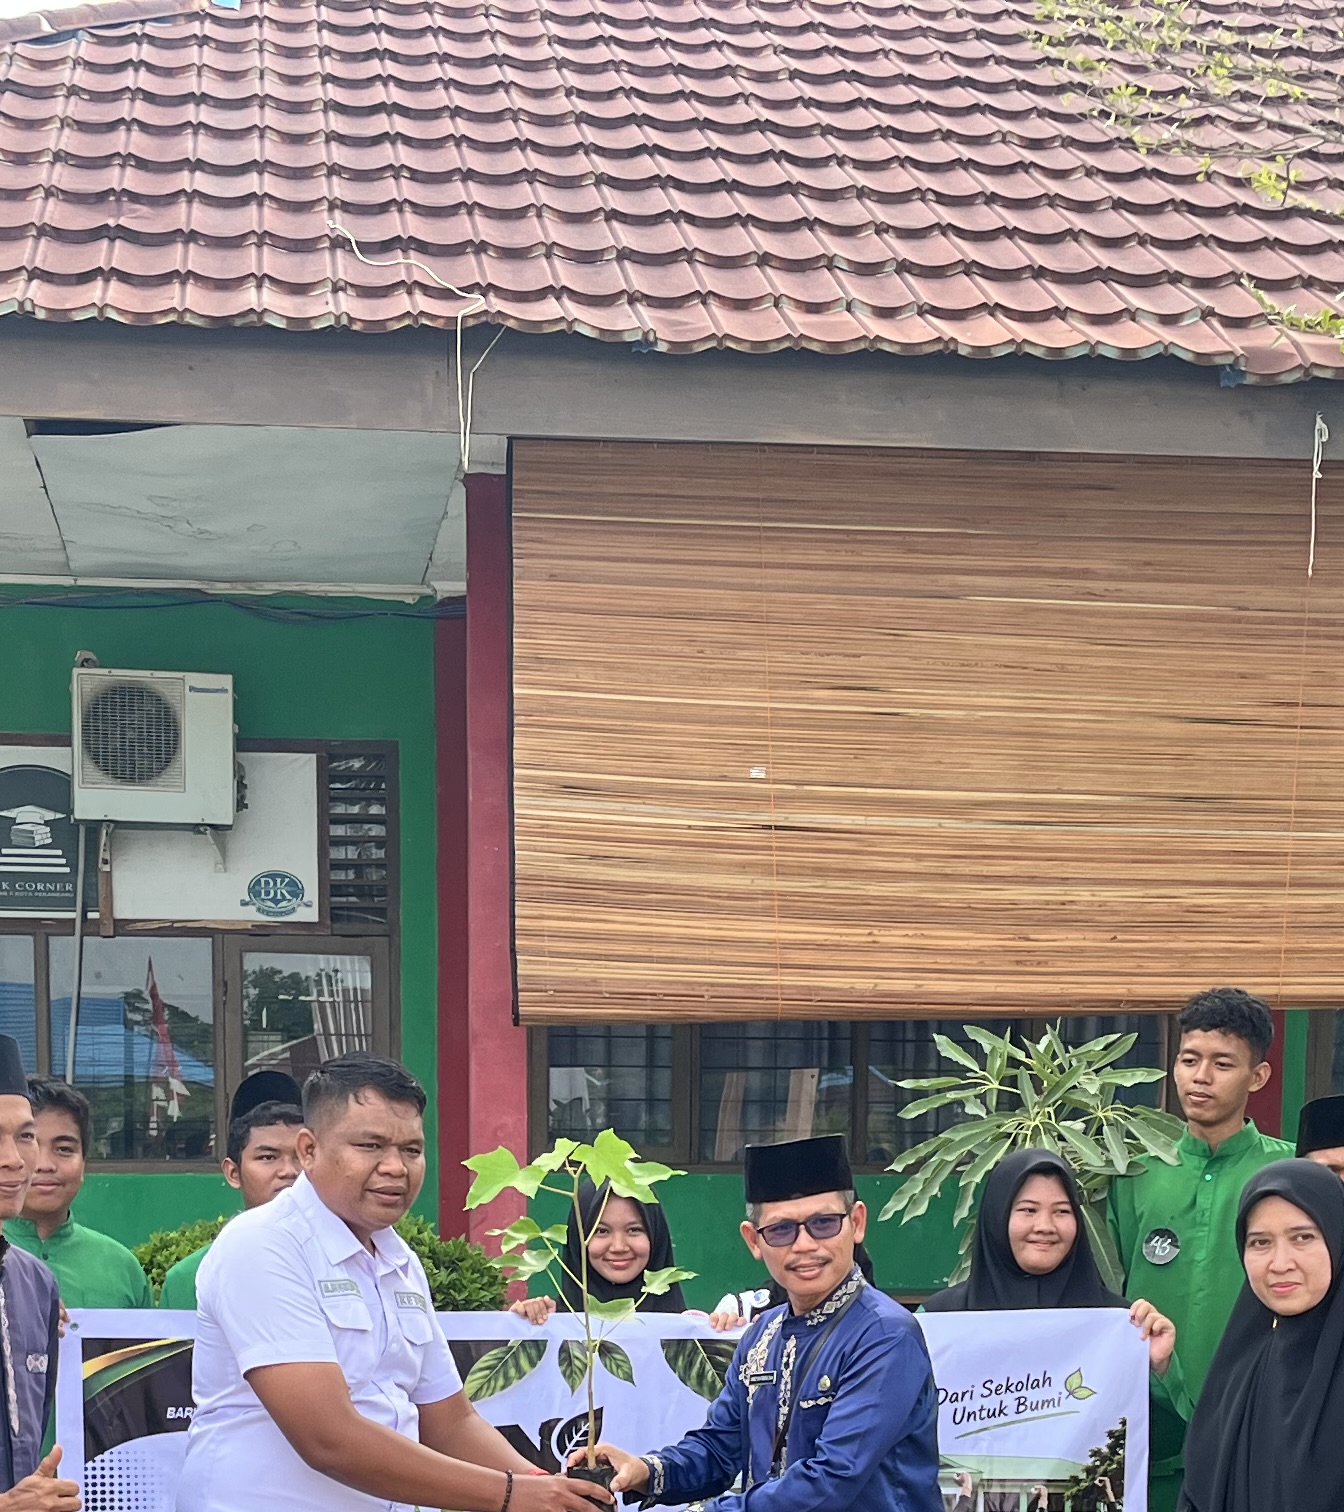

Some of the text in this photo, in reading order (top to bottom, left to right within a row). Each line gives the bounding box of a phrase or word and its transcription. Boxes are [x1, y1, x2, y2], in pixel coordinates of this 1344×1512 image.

[16, 882, 73, 891] CORNER
[259, 877, 293, 900] BK
[937, 1370, 1053, 1406] Dari Sekolah
[952, 1392, 1063, 1426] Untuk Bumi
